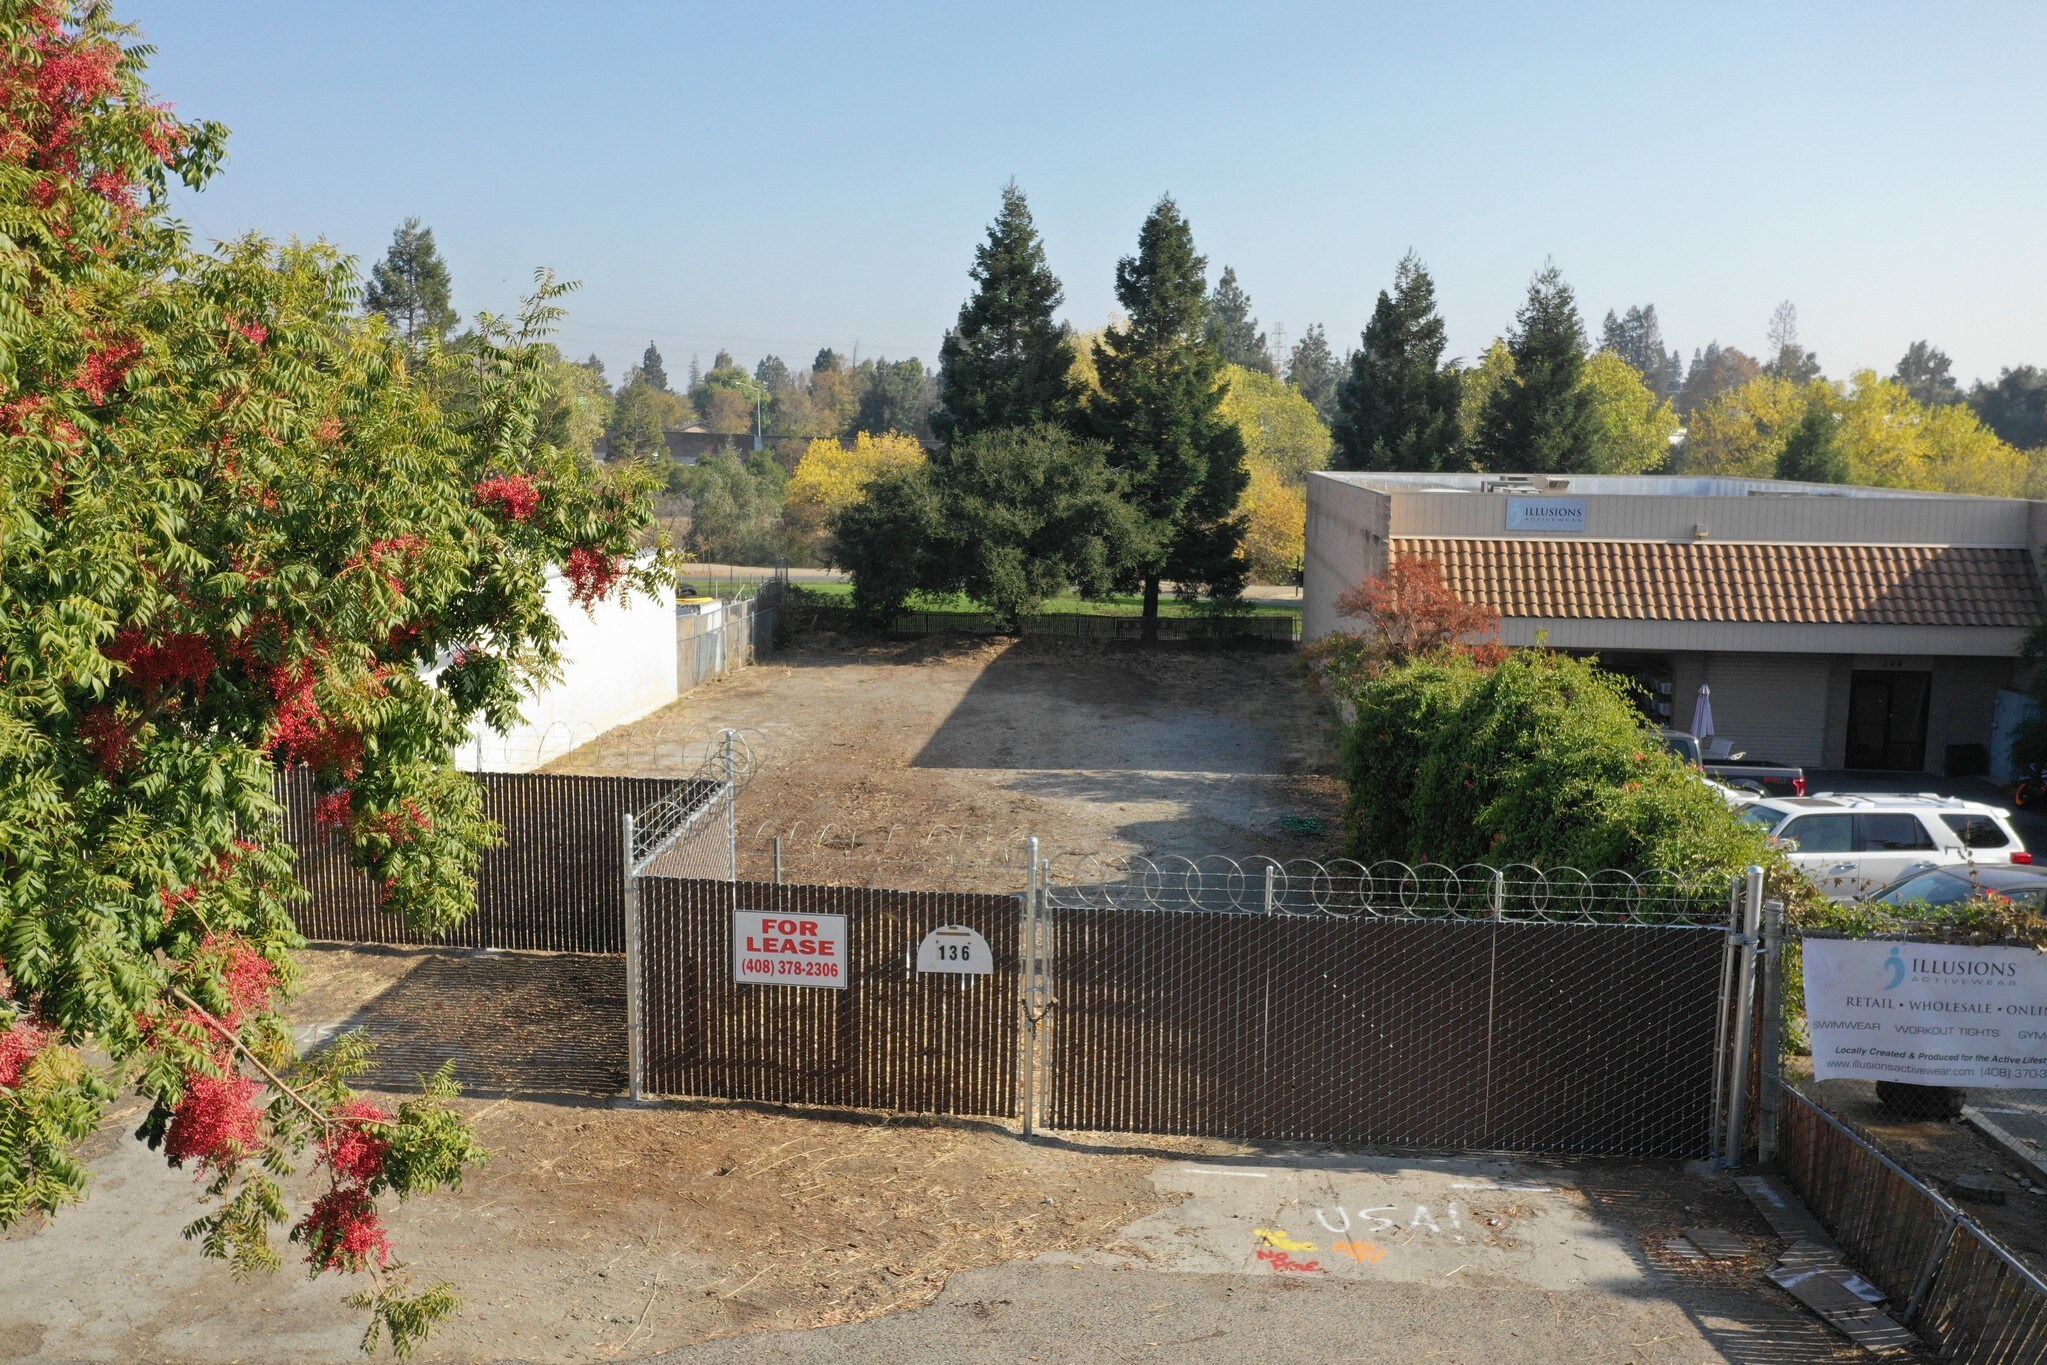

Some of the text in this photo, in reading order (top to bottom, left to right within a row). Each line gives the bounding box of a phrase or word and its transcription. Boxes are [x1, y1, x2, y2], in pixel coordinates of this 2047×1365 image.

[1525, 507, 1582, 517] ILLUSIONS
[762, 918, 818, 937] FOR
[746, 937, 835, 957] LEASE
[938, 945, 970, 962] 136
[741, 958, 839, 978] (408) 378-2306
[1912, 958, 2017, 978] ILLUSIONS
[1911, 976, 2017, 987] ACTIVEWEAR
[1846, 996, 1895, 1010] RETAIL
[1909, 1001, 1992, 1014] WHOLESALE
[1813, 1021, 2047, 1041] SWIMWEAR WORKOUT TIGHTS GYM
[1835, 1046, 2047, 1067] Locally Created & Produced for the Active Lifest
[1826, 1059, 1975, 1077] www.illusionsactivewear.com
[1980, 1066, 2012, 1079] (408)
